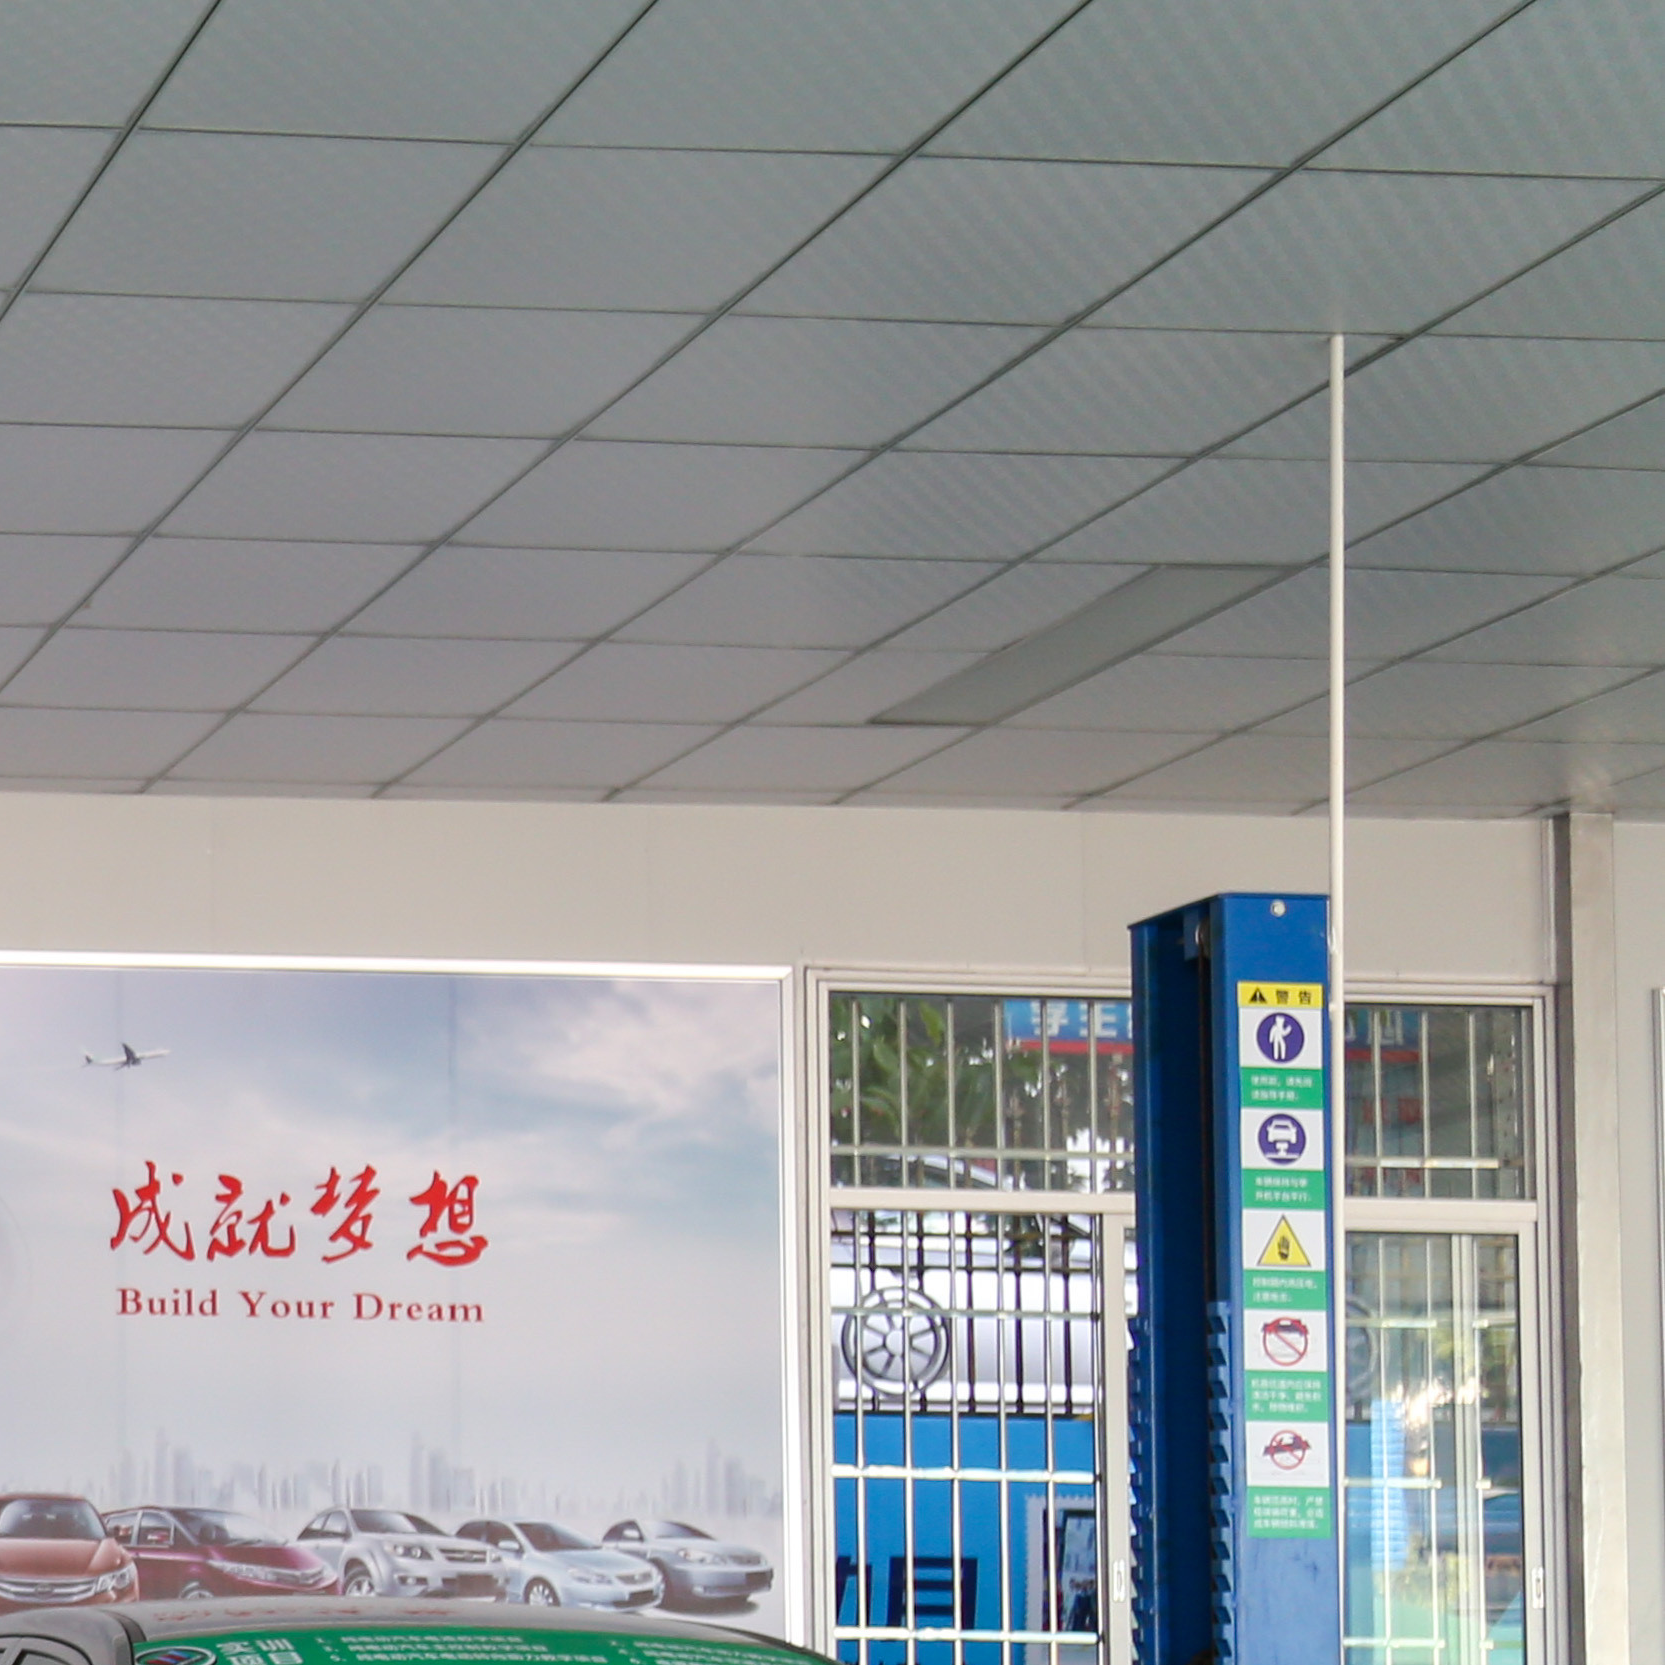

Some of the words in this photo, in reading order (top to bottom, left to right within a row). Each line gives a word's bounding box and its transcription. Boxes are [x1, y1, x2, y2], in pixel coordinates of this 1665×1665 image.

[1275, 990, 1312, 1005] 警告
[109, 1159, 489, 1268] 成就梦想
[116, 1287, 219, 1316] Build
[239, 1290, 336, 1320] Your
[353, 1292, 485, 1323] Dream
[216, 1638, 295, 1655] 实训
